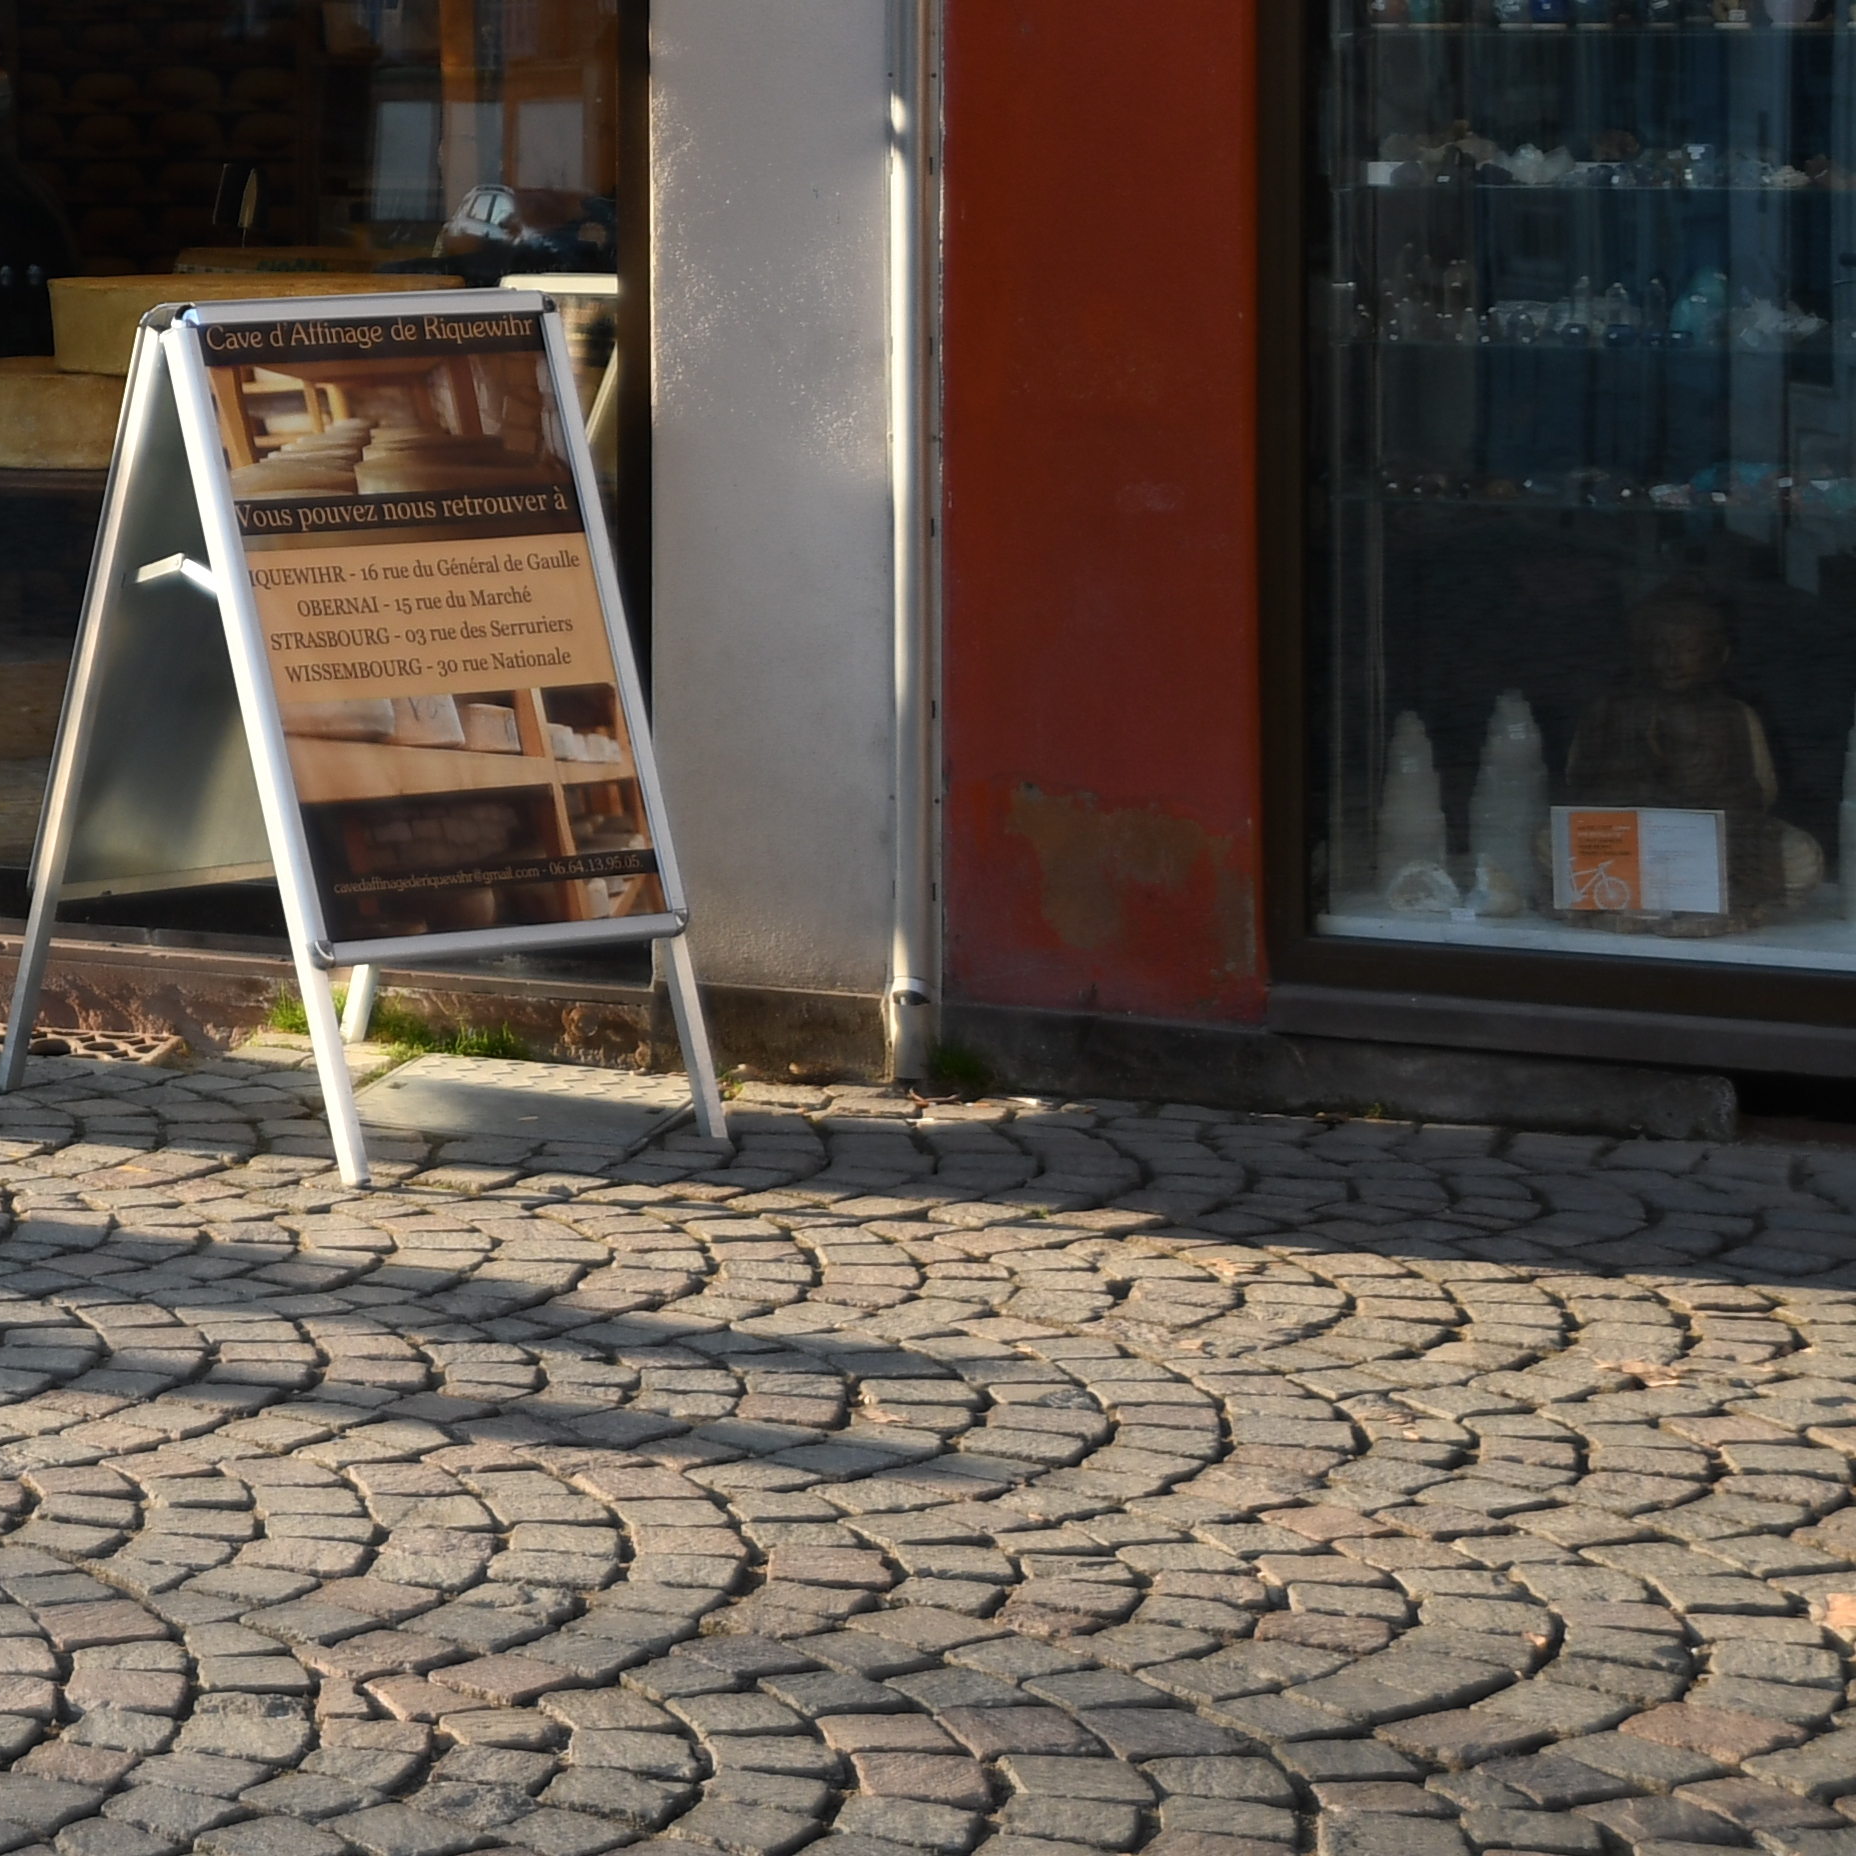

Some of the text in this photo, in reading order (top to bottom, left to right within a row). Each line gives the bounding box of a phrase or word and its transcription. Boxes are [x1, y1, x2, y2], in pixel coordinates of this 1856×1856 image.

[206, 313, 534, 351] Cave d'Affinage de Riquewihr
[235, 485, 569, 532] Vous pouvez nous retrouver à
[249, 565, 347, 591] IQUEWIHR
[360, 563, 379, 582] 16
[383, 565, 409, 581] rue
[413, 560, 435, 578] du
[437, 554, 500, 577] Général
[504, 554, 524, 572] de
[526, 549, 581, 571] Gaulle
[297, 595, 380, 618] OBERNAI
[395, 598, 413, 616] 15
[416, 596, 442, 612] rue
[447, 590, 467, 609] du
[470, 585, 532, 606] Marché
[270, 626, 390, 652] STRASBOURG
[405, 628, 427, 646] 03
[430, 626, 457, 642] rue
[460, 620, 488, 640] des
[490, 615, 574, 638] Serruriers
[284, 657, 423, 683] WISSEMBOURG
[437, 660, 458, 678] 30
[461, 656, 488, 673] rue
[491, 647, 572, 671] Nationale
